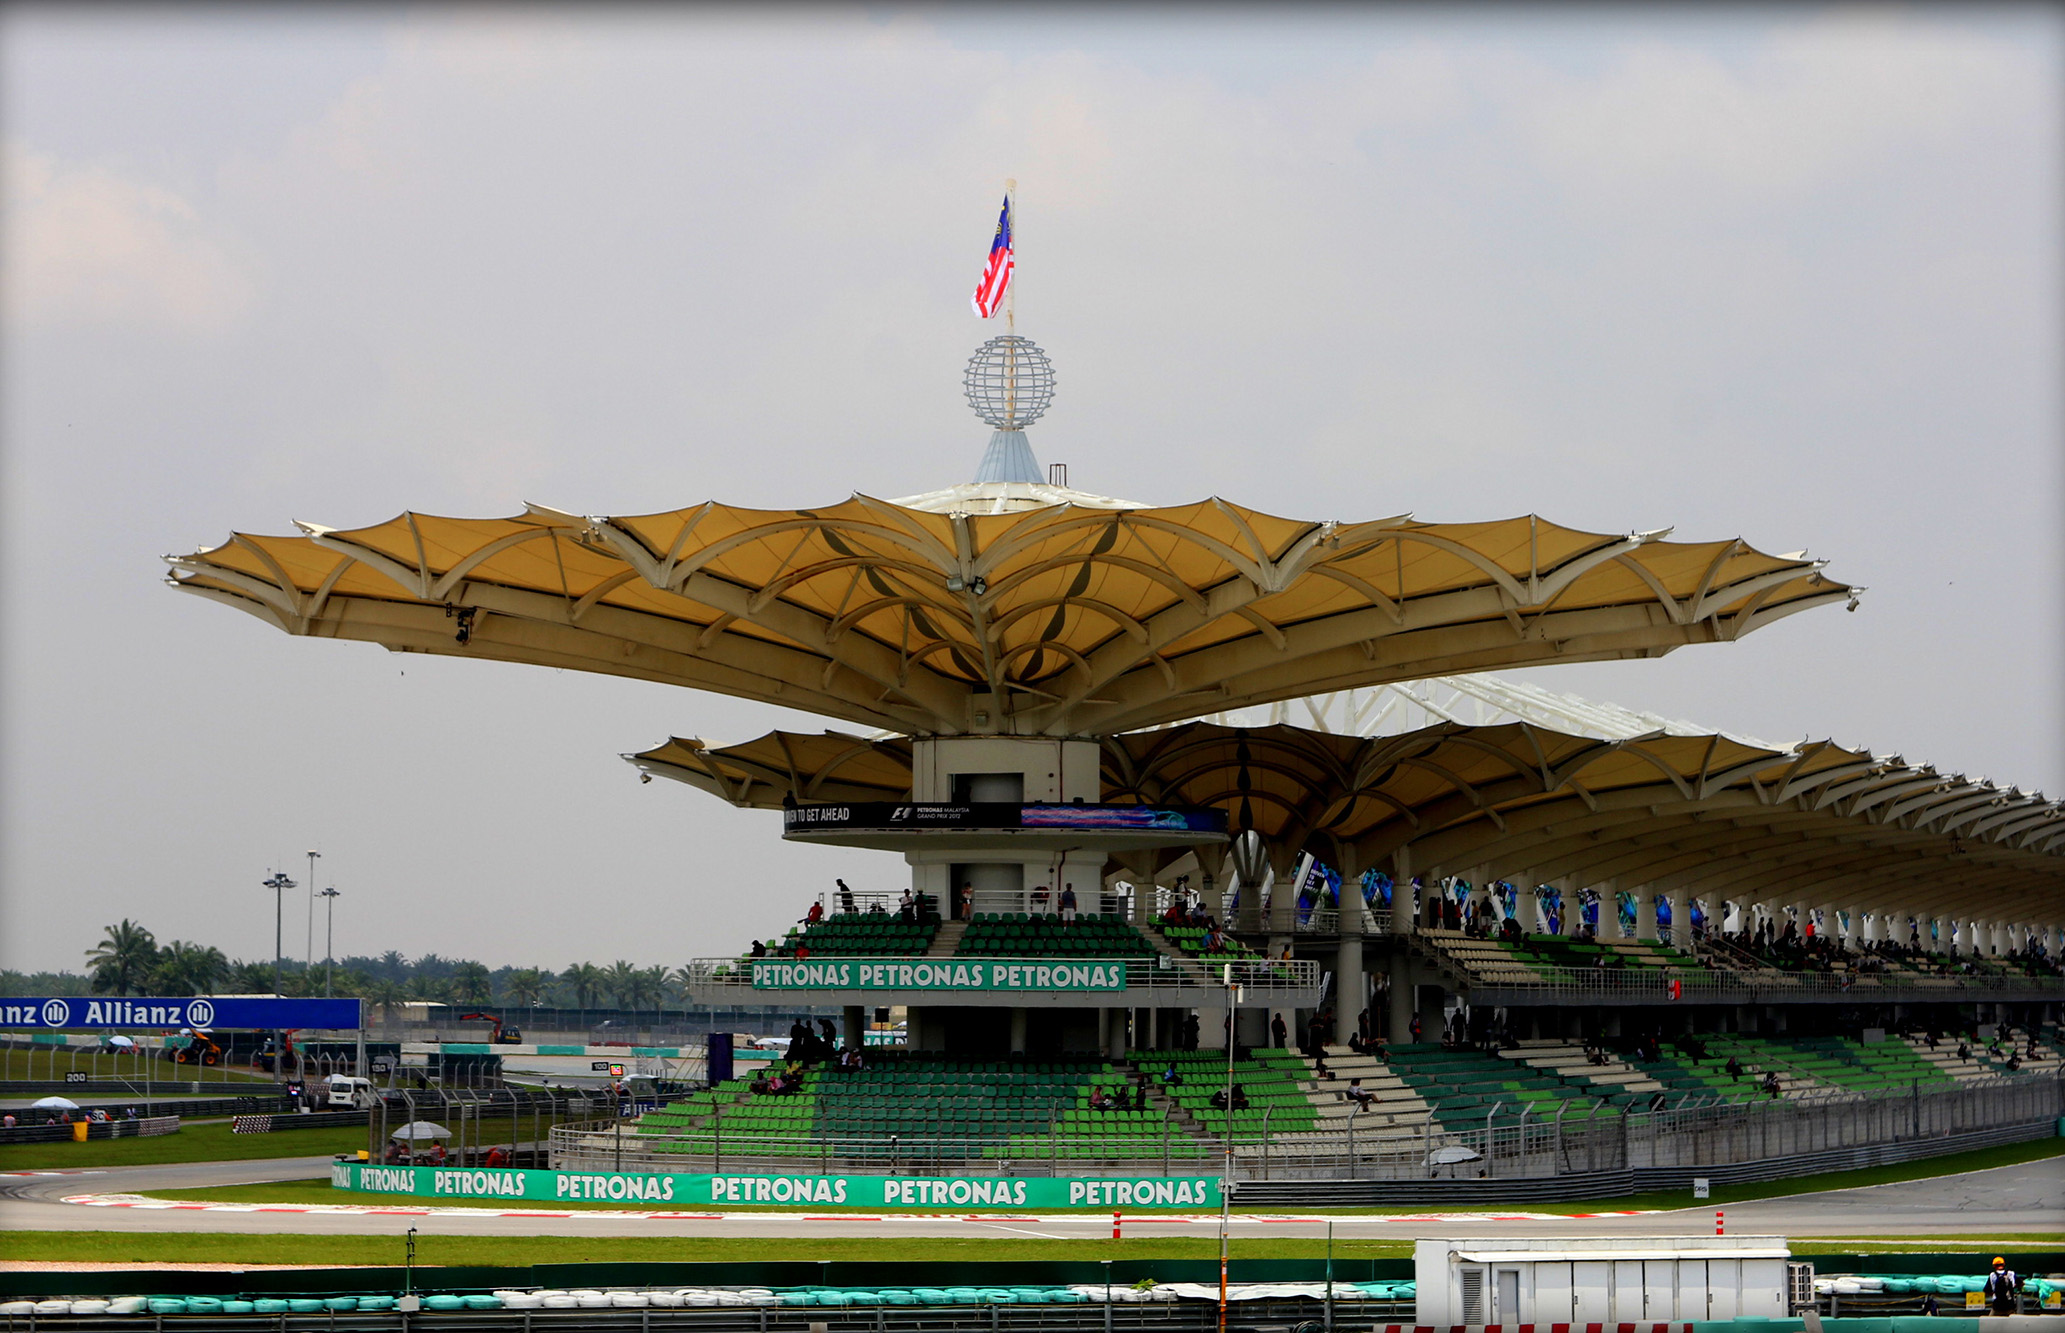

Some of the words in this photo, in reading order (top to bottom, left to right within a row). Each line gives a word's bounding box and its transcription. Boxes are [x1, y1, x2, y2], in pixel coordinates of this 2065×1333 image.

[798, 809, 805, 822] TO
[806, 808, 820, 822] GET
[820, 807, 850, 821] AHEAD
[753, 964, 850, 986] PETRONAS
[859, 964, 983, 987] PETRONAS
[992, 965, 1120, 988] PETRONAS
[85, 1001, 181, 1024] Allianz
[66, 1073, 86, 1083] 200
[91, 1111, 105, 1121] SC
[360, 1167, 415, 1192] PETRONAS
[434, 1171, 526, 1196] PETRONAS
[556, 1174, 675, 1201] PETRONAS
[711, 1177, 847, 1203] PETRONAS
[884, 1179, 1027, 1205] PETRONAS
[1069, 1180, 1207, 1205] PETRONAS
